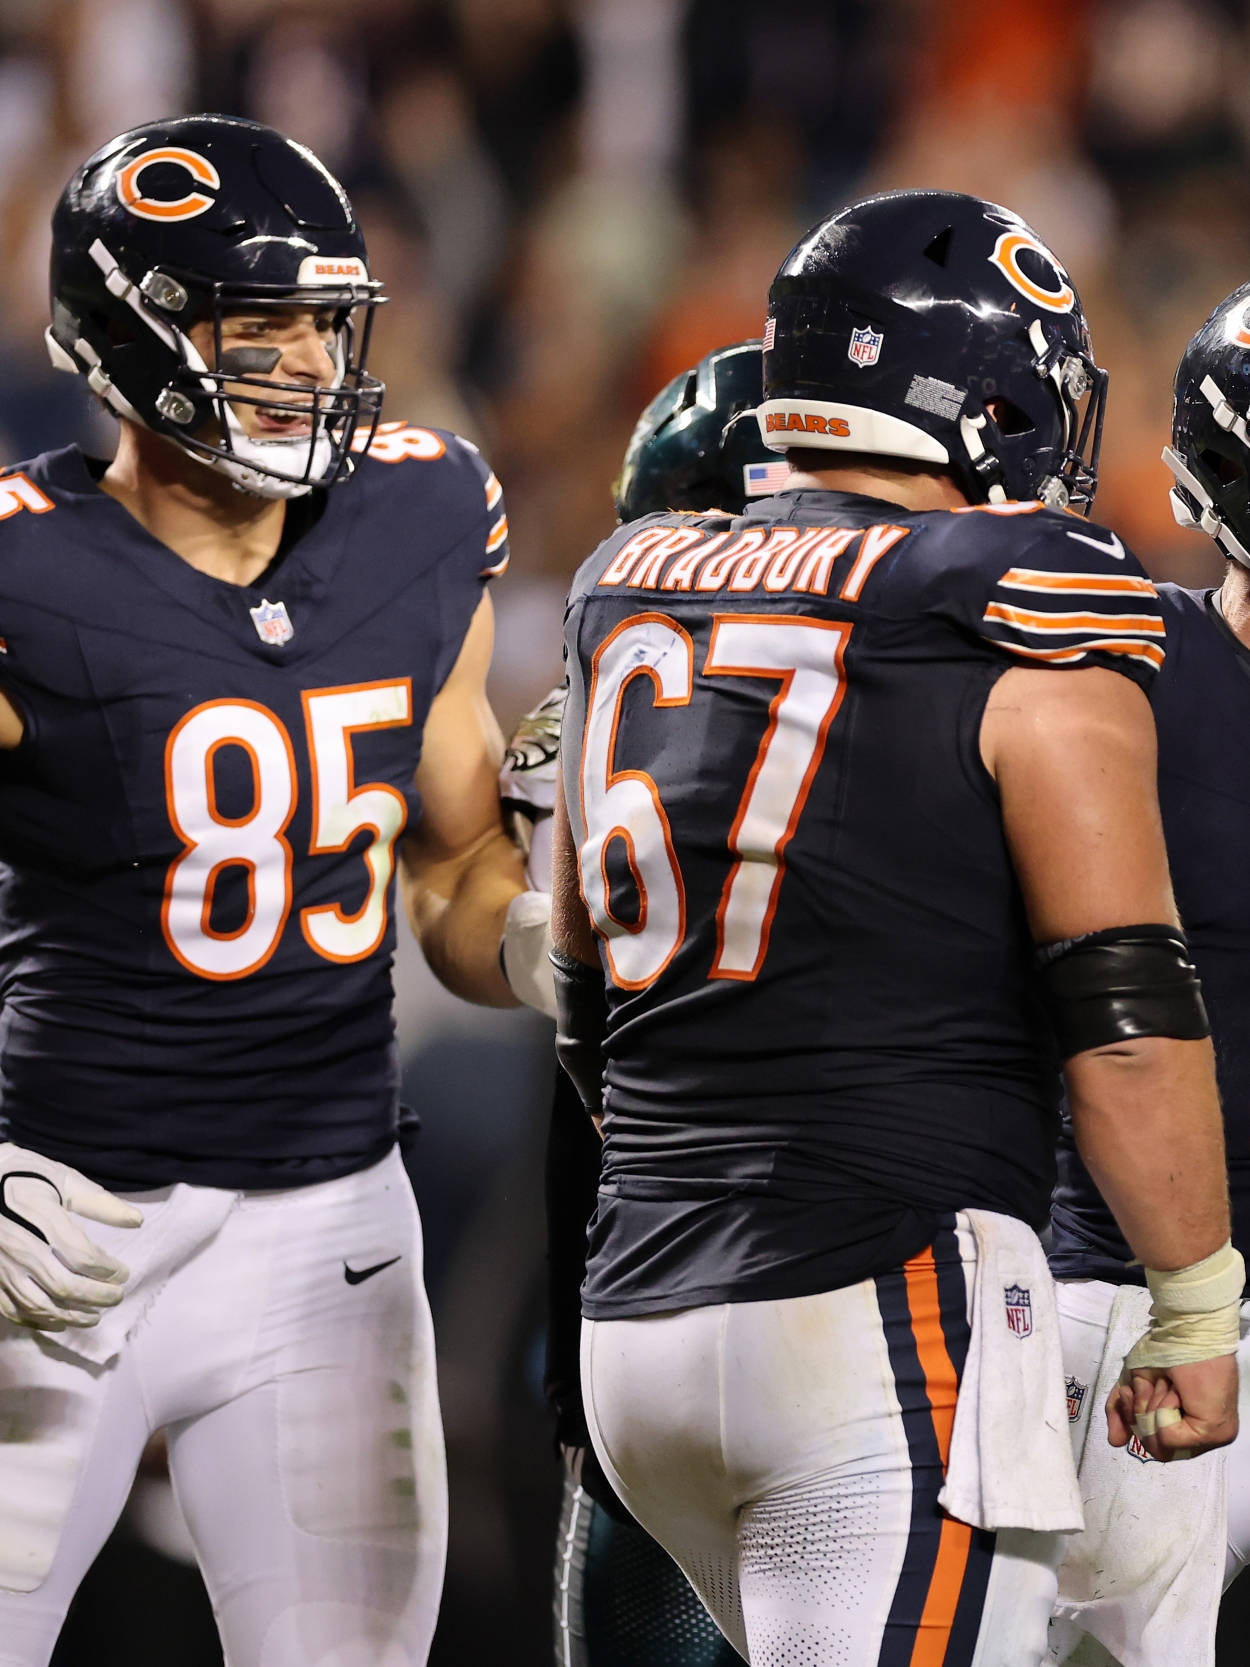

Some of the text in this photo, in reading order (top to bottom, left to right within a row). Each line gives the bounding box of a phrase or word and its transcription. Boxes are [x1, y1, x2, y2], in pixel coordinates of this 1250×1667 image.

[315, 264, 361, 276] BEARS
[852, 343, 876, 361] NFL
[765, 412, 851, 438] BEARS
[597, 523, 911, 602] BRADBURY
[262, 619, 288, 637] NFL
[576, 611, 855, 992] 67
[160, 676, 414, 982] 85
[1005, 1307, 1030, 1335] NFL
[1066, 1398, 1077, 1417] FL
